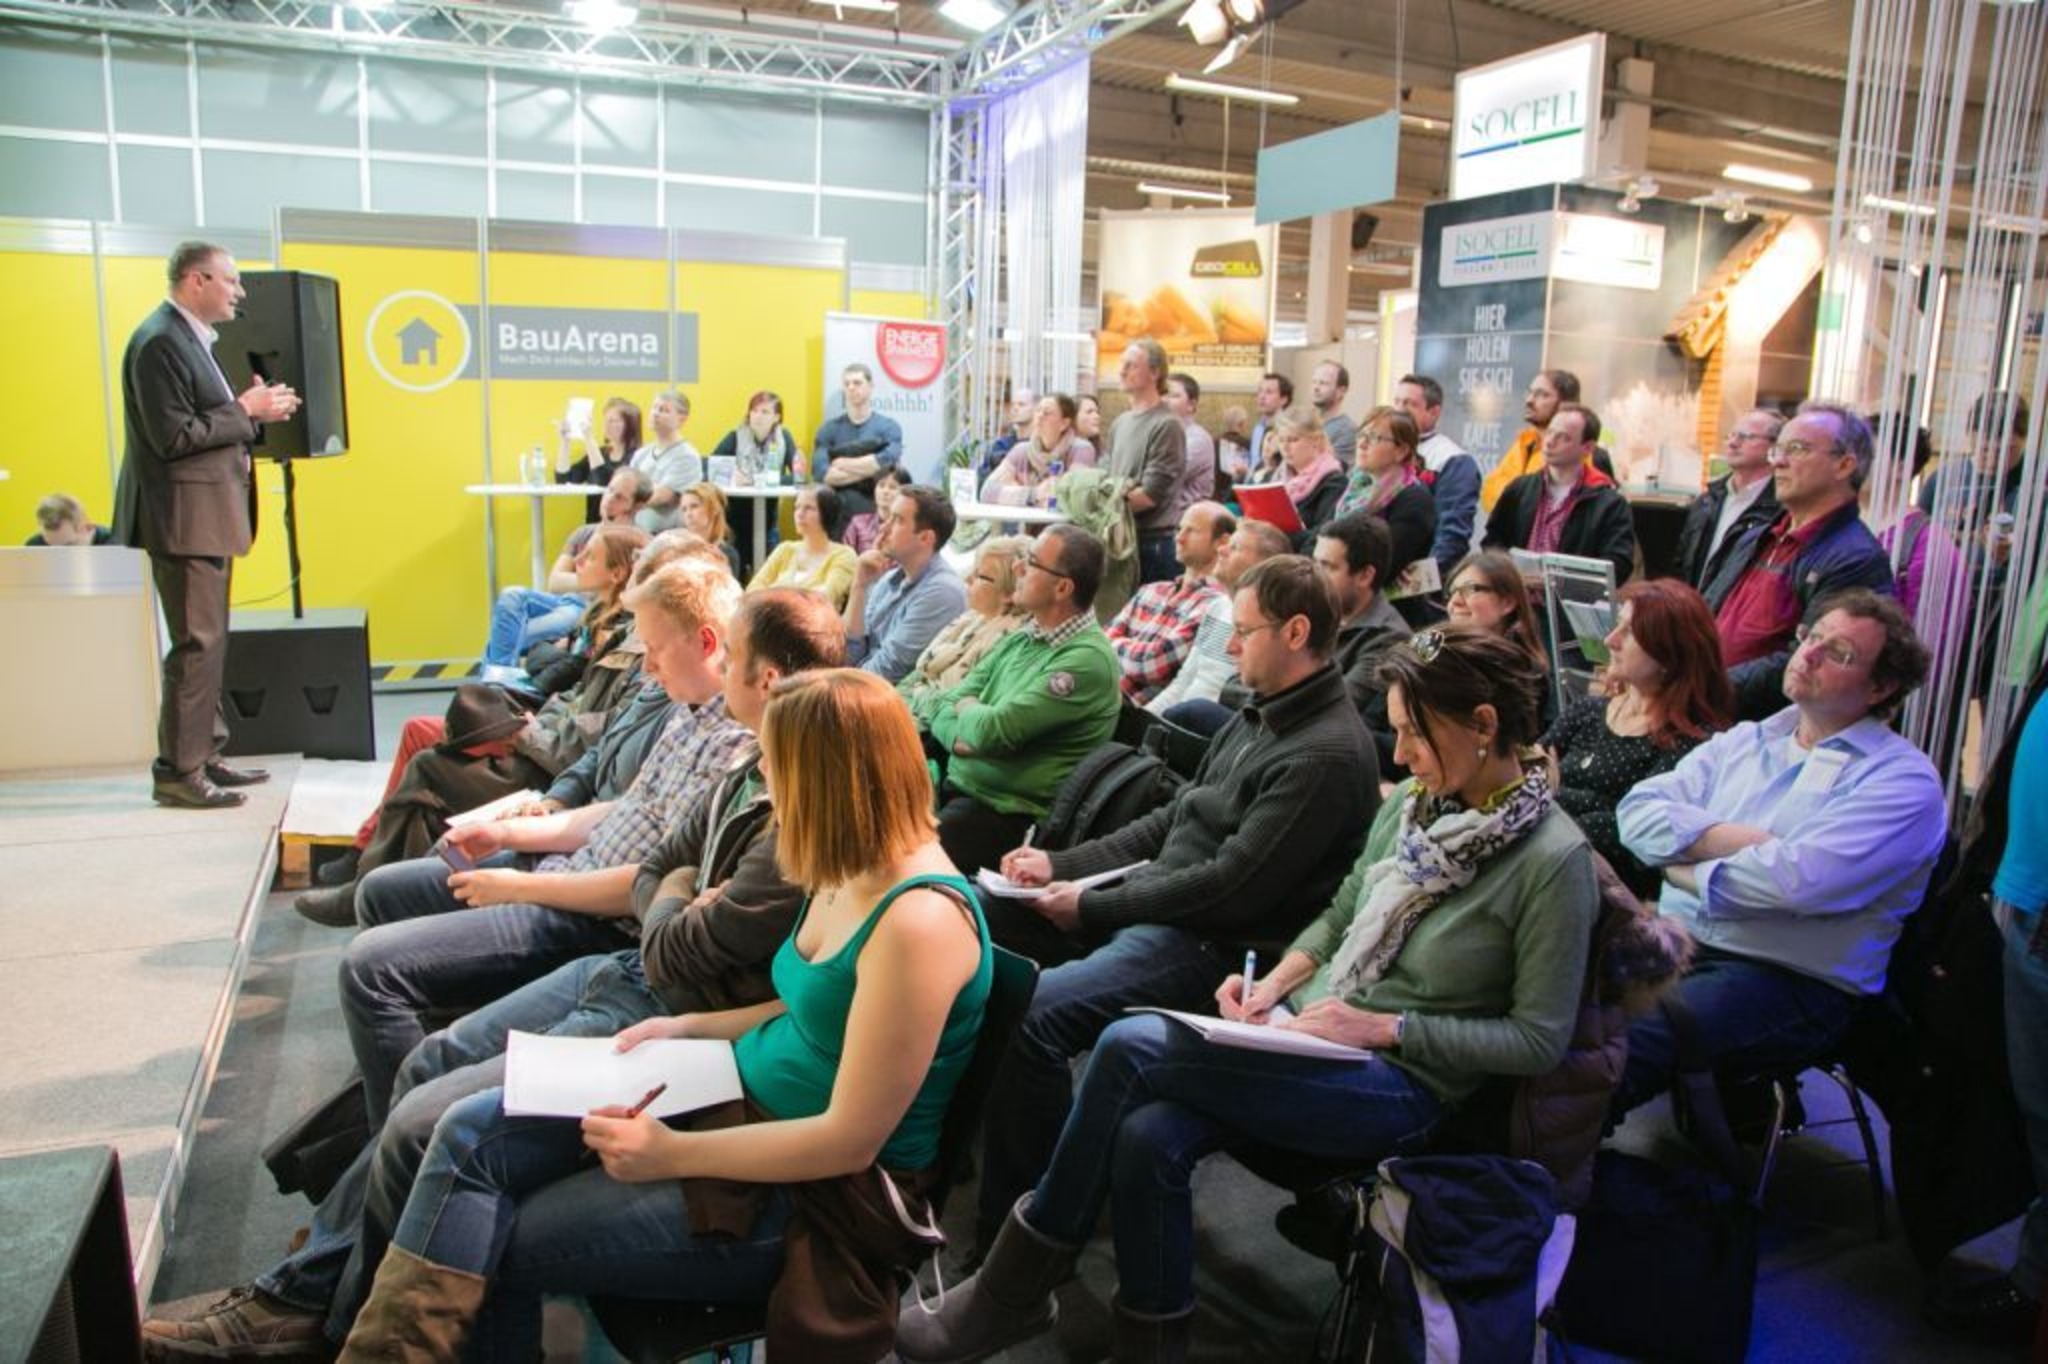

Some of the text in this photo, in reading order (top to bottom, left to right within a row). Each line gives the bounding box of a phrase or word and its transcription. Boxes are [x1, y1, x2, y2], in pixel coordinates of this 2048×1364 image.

[1474, 304, 1507, 331] HIER
[498, 323, 659, 354] BauArena
[1466, 335, 1511, 363] HOLEN
[1483, 367, 1513, 394] SICH
